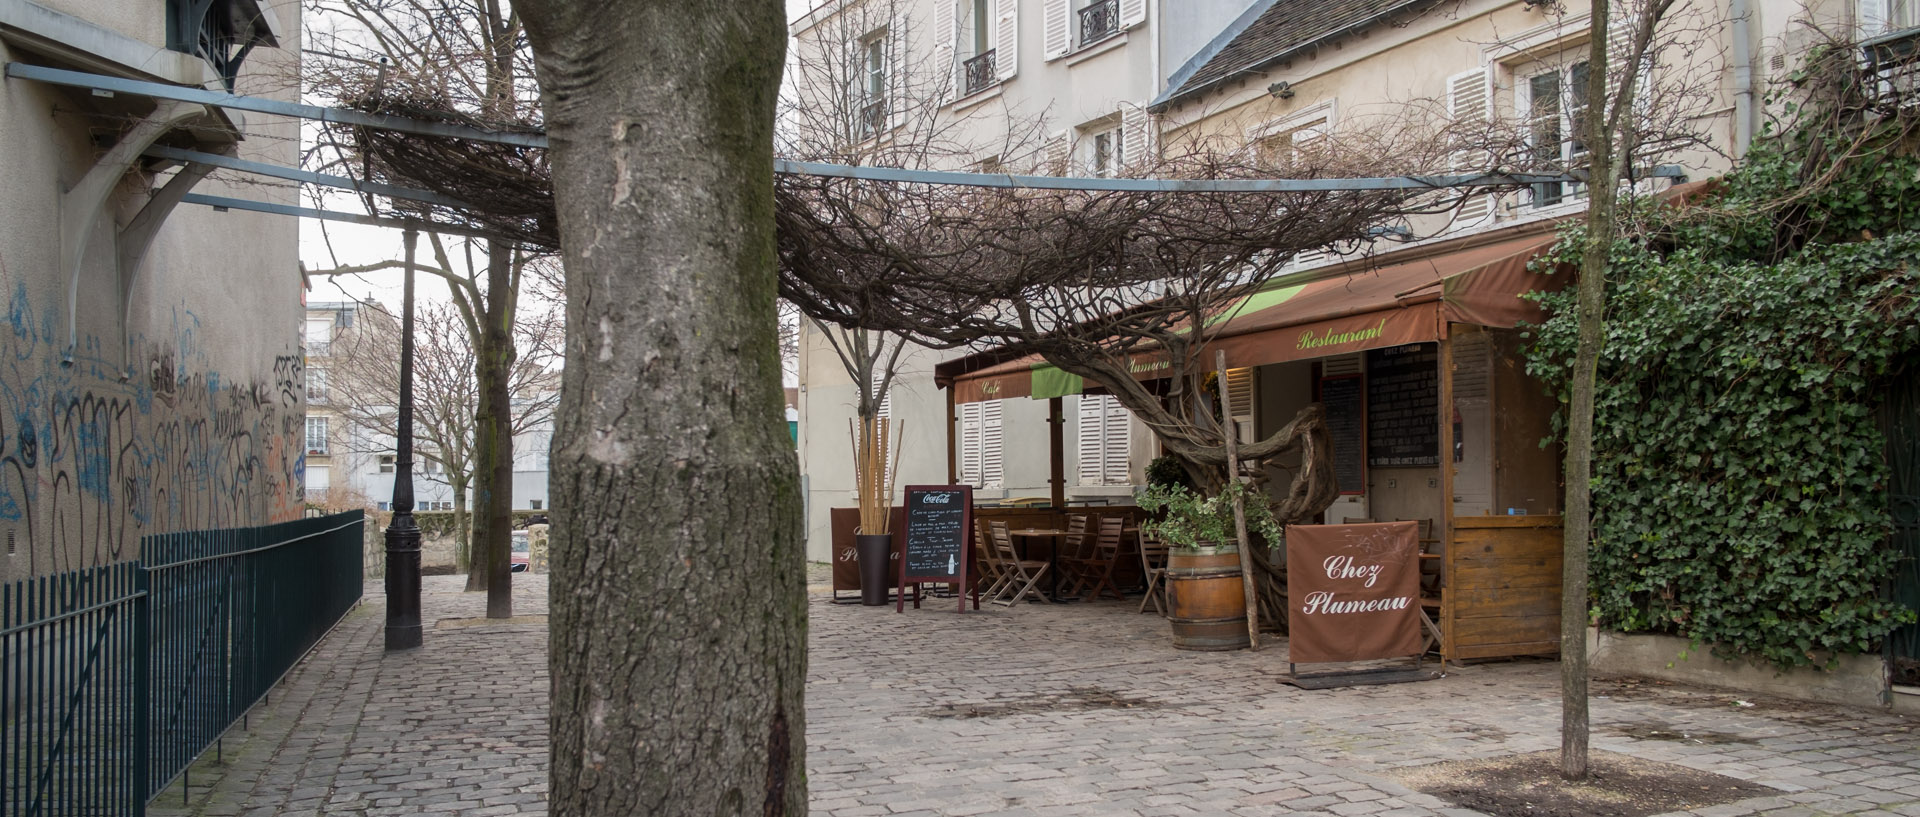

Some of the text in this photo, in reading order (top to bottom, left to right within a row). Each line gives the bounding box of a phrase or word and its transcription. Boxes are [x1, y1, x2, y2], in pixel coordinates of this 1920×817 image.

[1296, 318, 1386, 350] Restaurant
[982, 380, 1001, 395] Café
[1323, 555, 1384, 588] Chez
[1302, 590, 1413, 615] Plumeau
